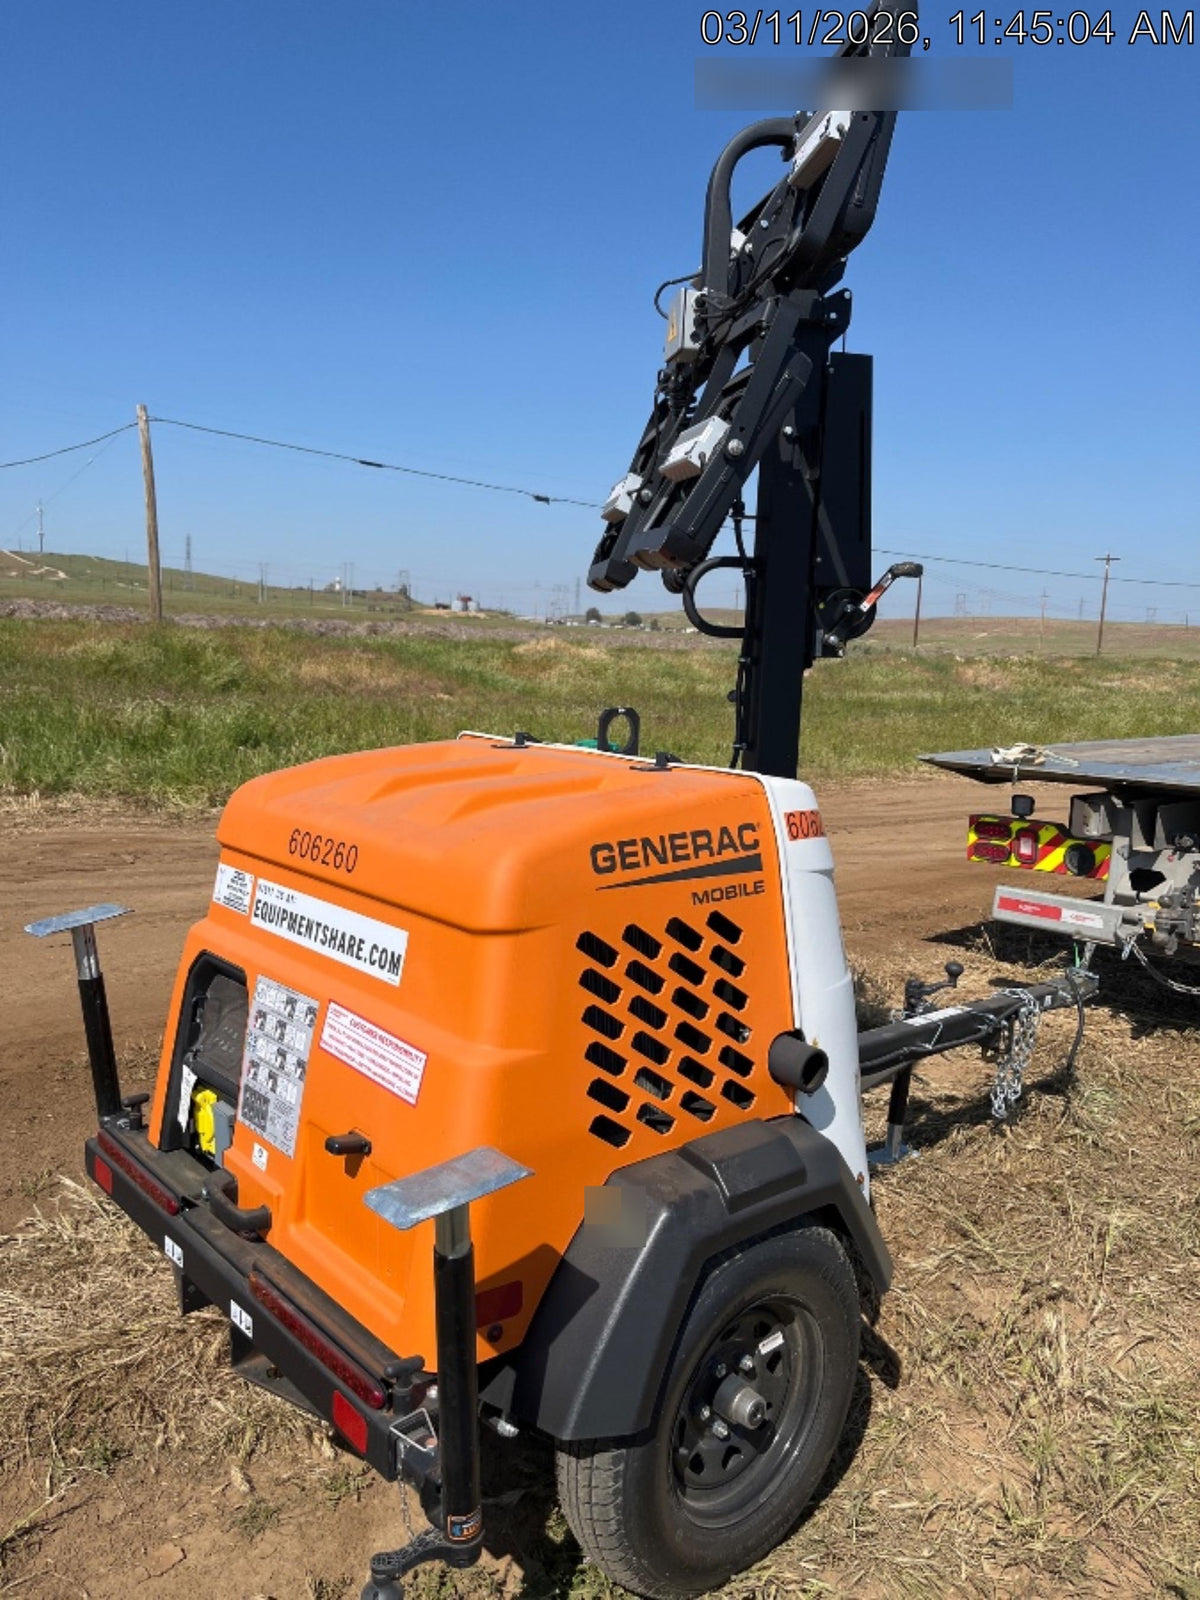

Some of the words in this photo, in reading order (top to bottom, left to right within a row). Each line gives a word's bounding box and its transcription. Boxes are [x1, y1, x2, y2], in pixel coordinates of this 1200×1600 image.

[289, 829, 358, 873] 606260
[590, 822, 760, 875] GENERAC
[691, 880, 765, 905] MOBILE
[253, 899, 402, 976] EQUIPMENTSHARE.COM
